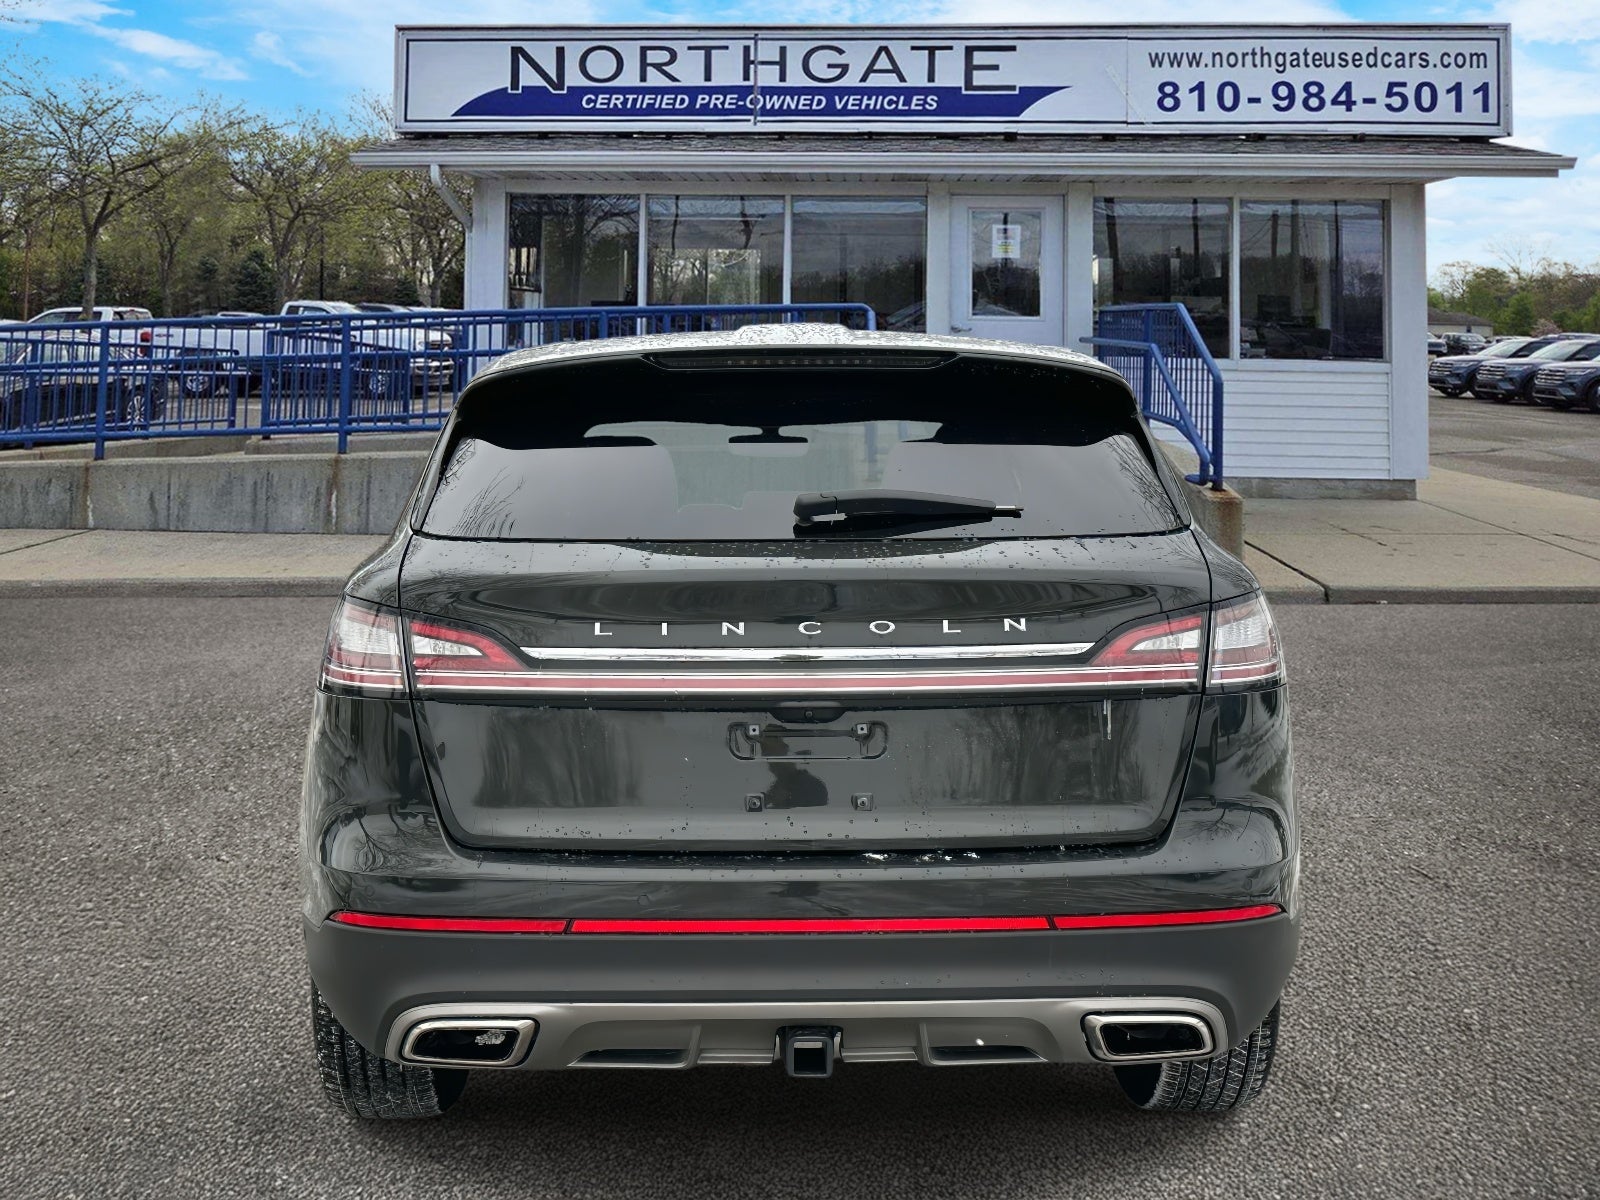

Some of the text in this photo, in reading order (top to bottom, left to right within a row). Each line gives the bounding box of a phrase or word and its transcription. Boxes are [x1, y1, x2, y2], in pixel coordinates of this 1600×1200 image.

[509, 44, 1017, 92] NORTHGATE
[1149, 47, 1488, 73] www.northgateusedcars.com
[581, 94, 938, 111] CERTIFIED PRE-OWNED VEHICLES
[1156, 80, 1491, 113] 810-984-5011
[594, 617, 1027, 636] LINCOLN
